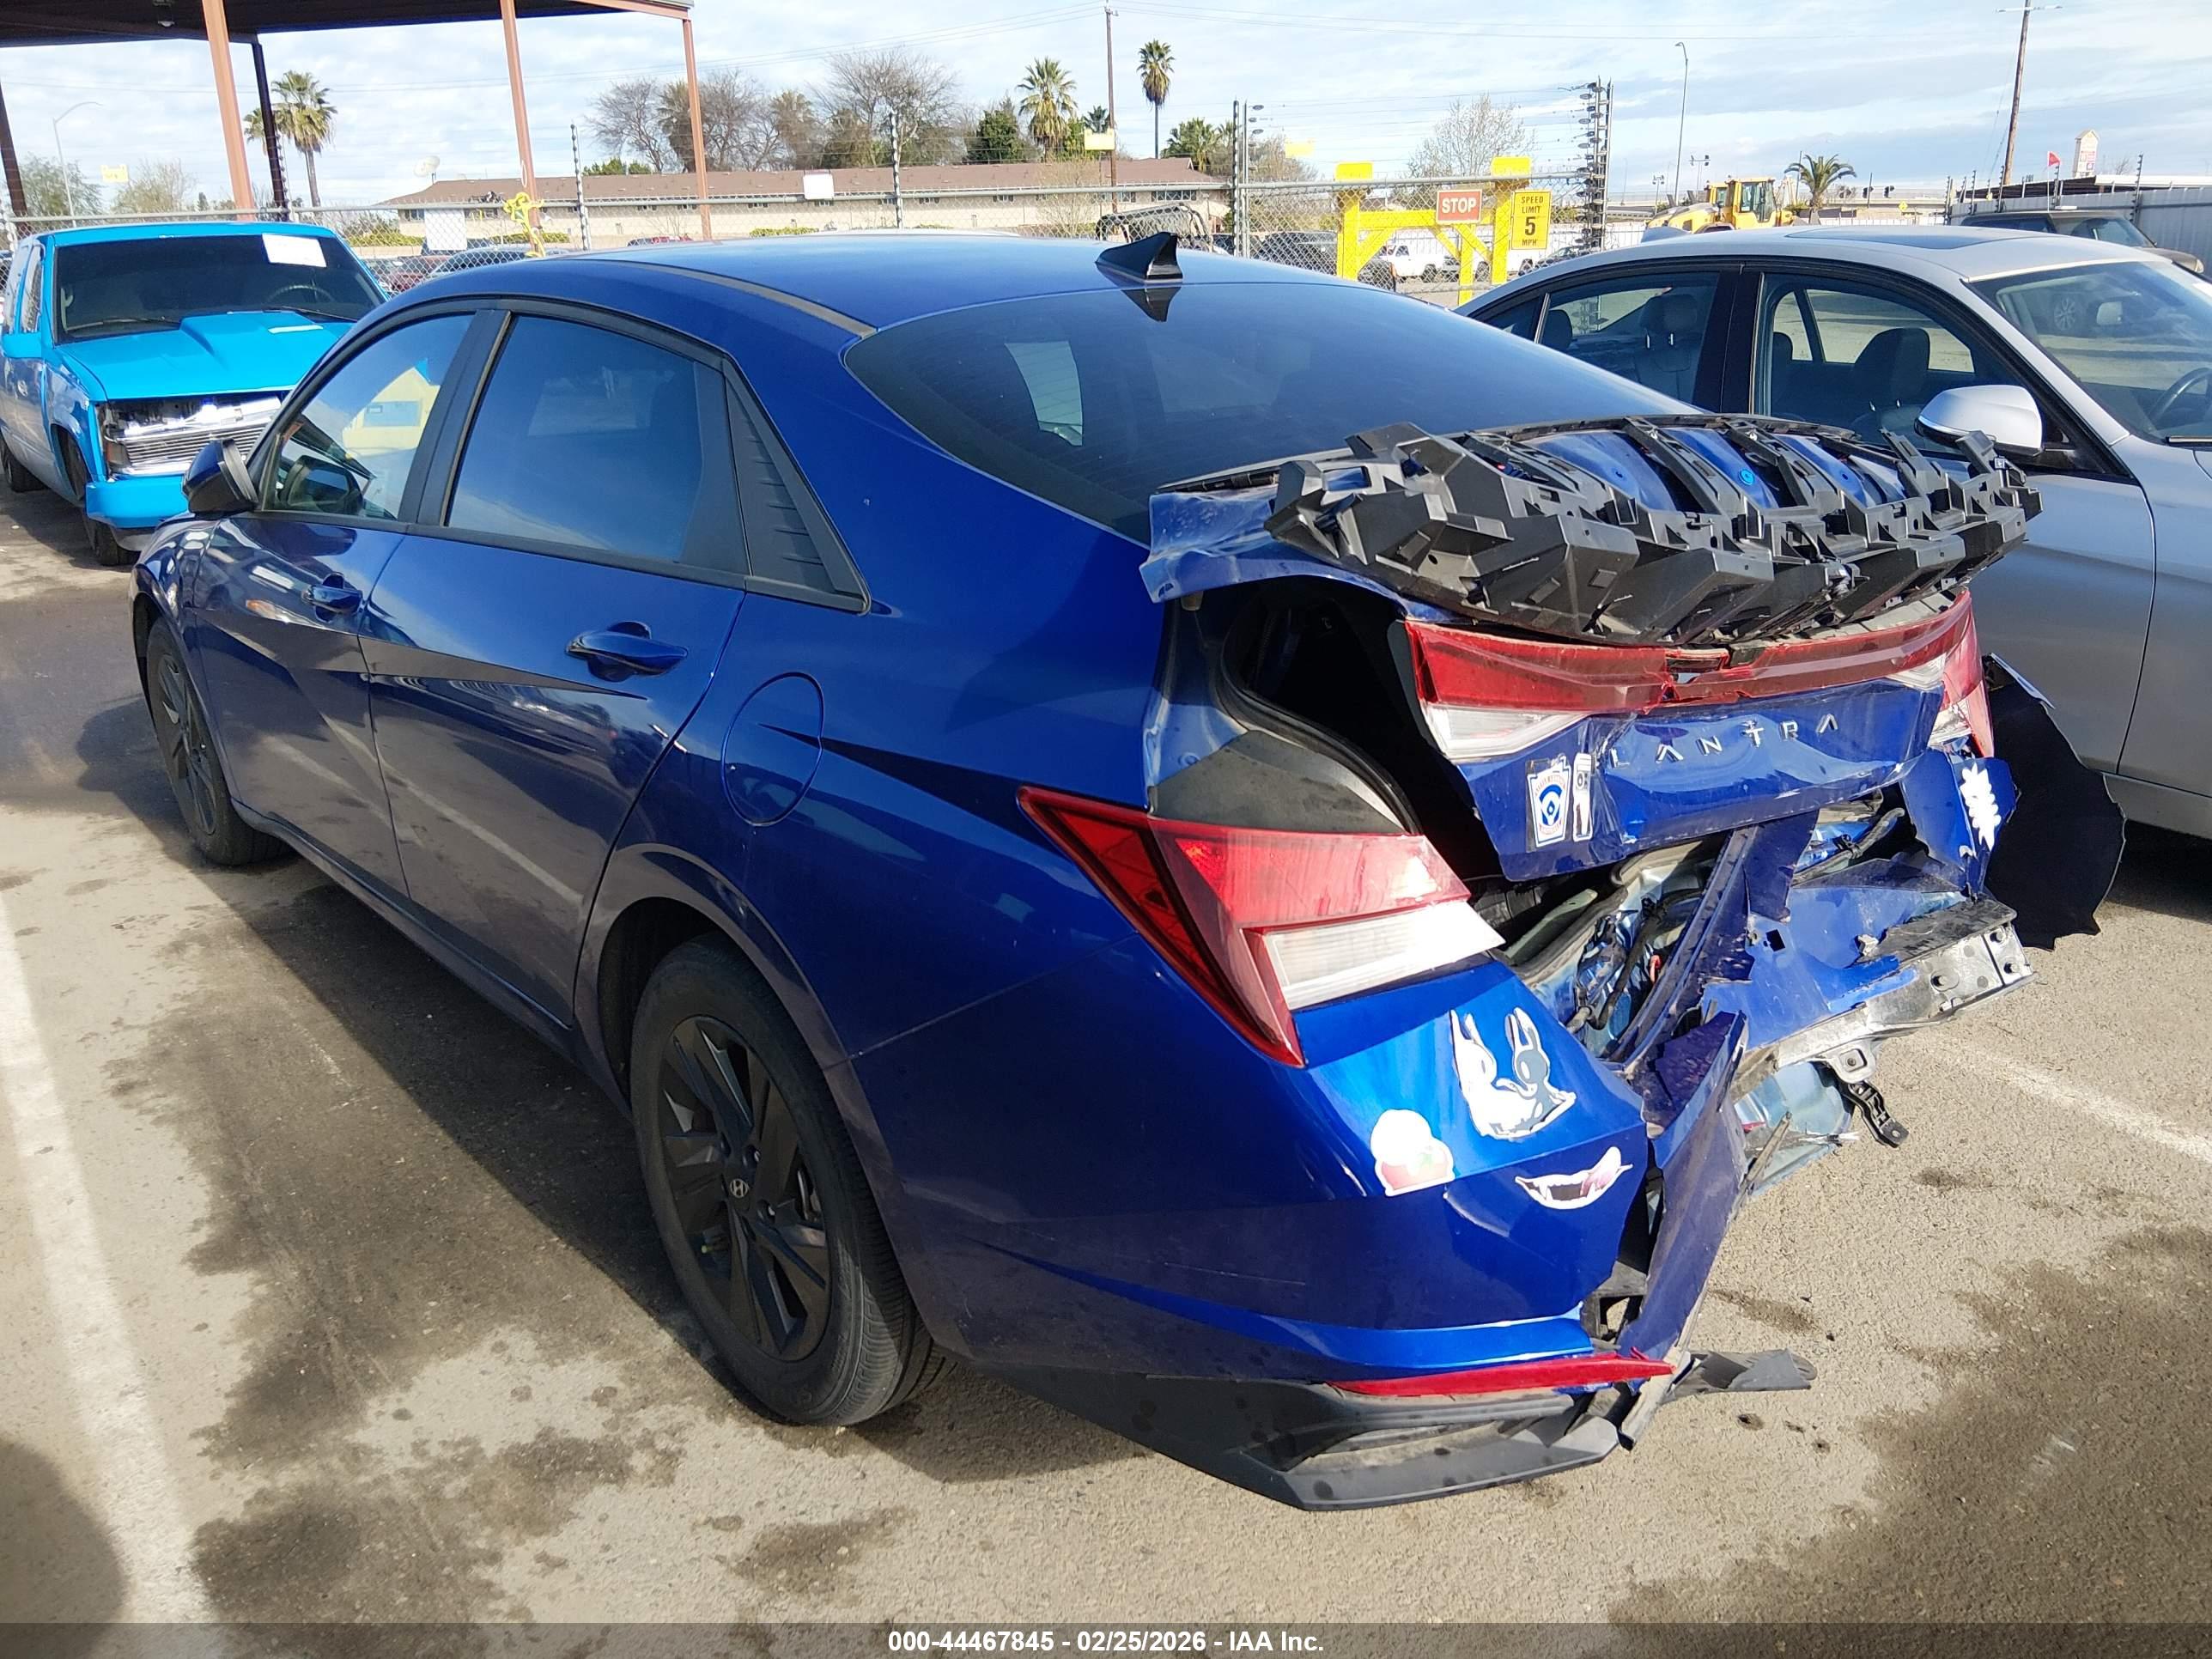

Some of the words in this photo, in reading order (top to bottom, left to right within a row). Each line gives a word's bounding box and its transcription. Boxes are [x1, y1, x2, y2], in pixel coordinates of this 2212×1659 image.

[1442, 197, 1477, 214] STOP
[1521, 196, 1544, 204] SPEED
[1522, 205, 1540, 214] LIMIT
[1524, 216, 1536, 236] 5
[1595, 713, 1838, 769] LANTRA
